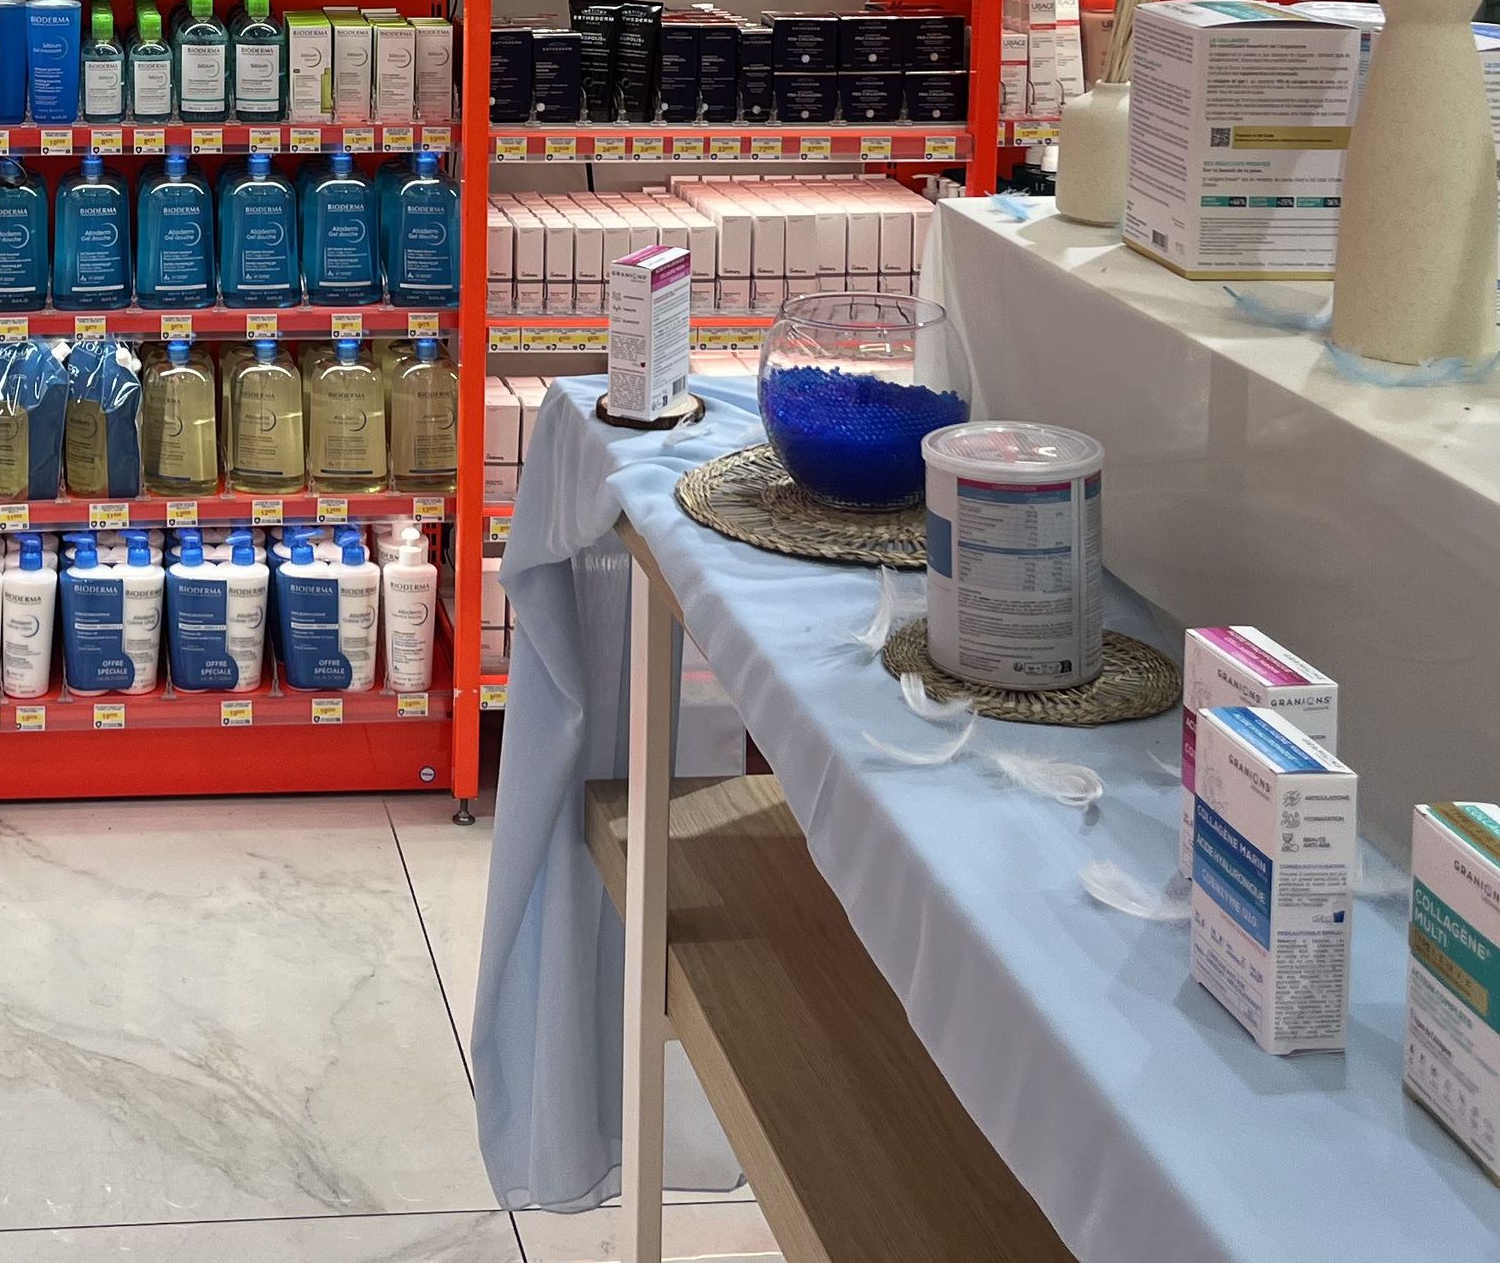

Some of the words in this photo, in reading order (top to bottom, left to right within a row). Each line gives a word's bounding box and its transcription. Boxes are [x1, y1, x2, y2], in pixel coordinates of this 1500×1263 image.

[79, 207, 118, 216] BIODERMA
[407, 205, 445, 214] BIODERMA
[87, 229, 112, 239] Atoderm
[170, 228, 195, 238] Atoderm
[74, 586, 118, 595] BIODERMA
[178, 586, 222, 595] BIODERMA
[290, 584, 333, 594] BIODERMA
[102, 660, 124, 668] OFFRE
[205, 659, 227, 668] OFFRE
[319, 658, 341, 667] OFFRE
[97, 667, 128, 676] SPÉCIALE
[201, 667, 232, 676] SPÉCIALE
[314, 666, 345, 675] SPÉCIALE
[1217, 669, 1262, 704] GRANIONS
[1271, 696, 1330, 707] GRANIONS
[1228, 754, 1270, 793] GRANIONS
[1197, 804, 1239, 850] COLLAGÈNE
[1240, 845, 1267, 872] MARIN
[1415, 889, 1486, 960] COLLAGÈNE
[1415, 909, 1448, 947] MULTI
